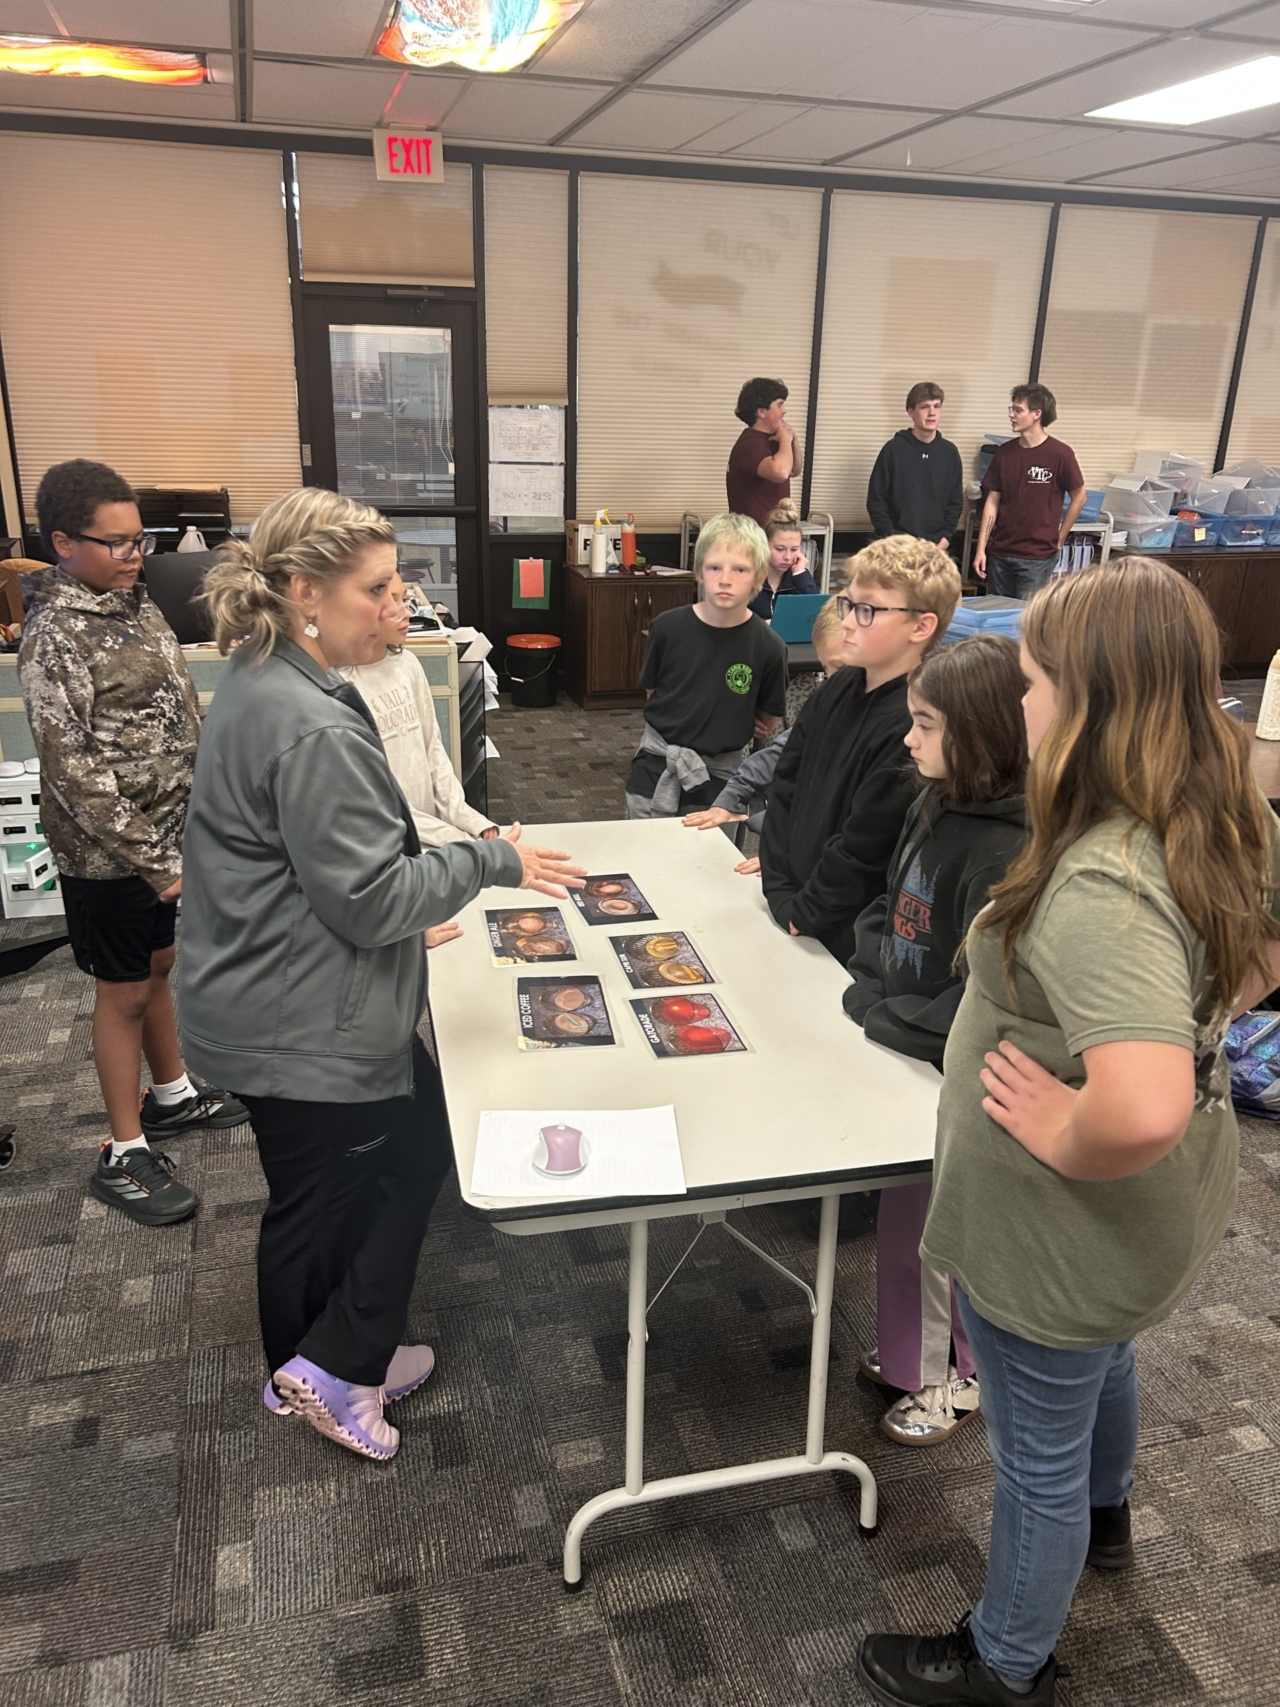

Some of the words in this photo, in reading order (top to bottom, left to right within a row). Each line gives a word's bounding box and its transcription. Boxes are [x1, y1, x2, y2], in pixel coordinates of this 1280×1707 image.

[386, 136, 433, 175] EXIT
[1031, 466, 1049, 482] VTC
[378, 688, 406, 711] VAIL
[377, 703, 419, 733] OLORAD
[488, 922, 499, 931] ALE
[490, 930, 503, 948] GINGER
[519, 993, 532, 1014] COFFEE
[521, 1014, 534, 1029] ICED
[638, 1013, 661, 1044] GATORADE
